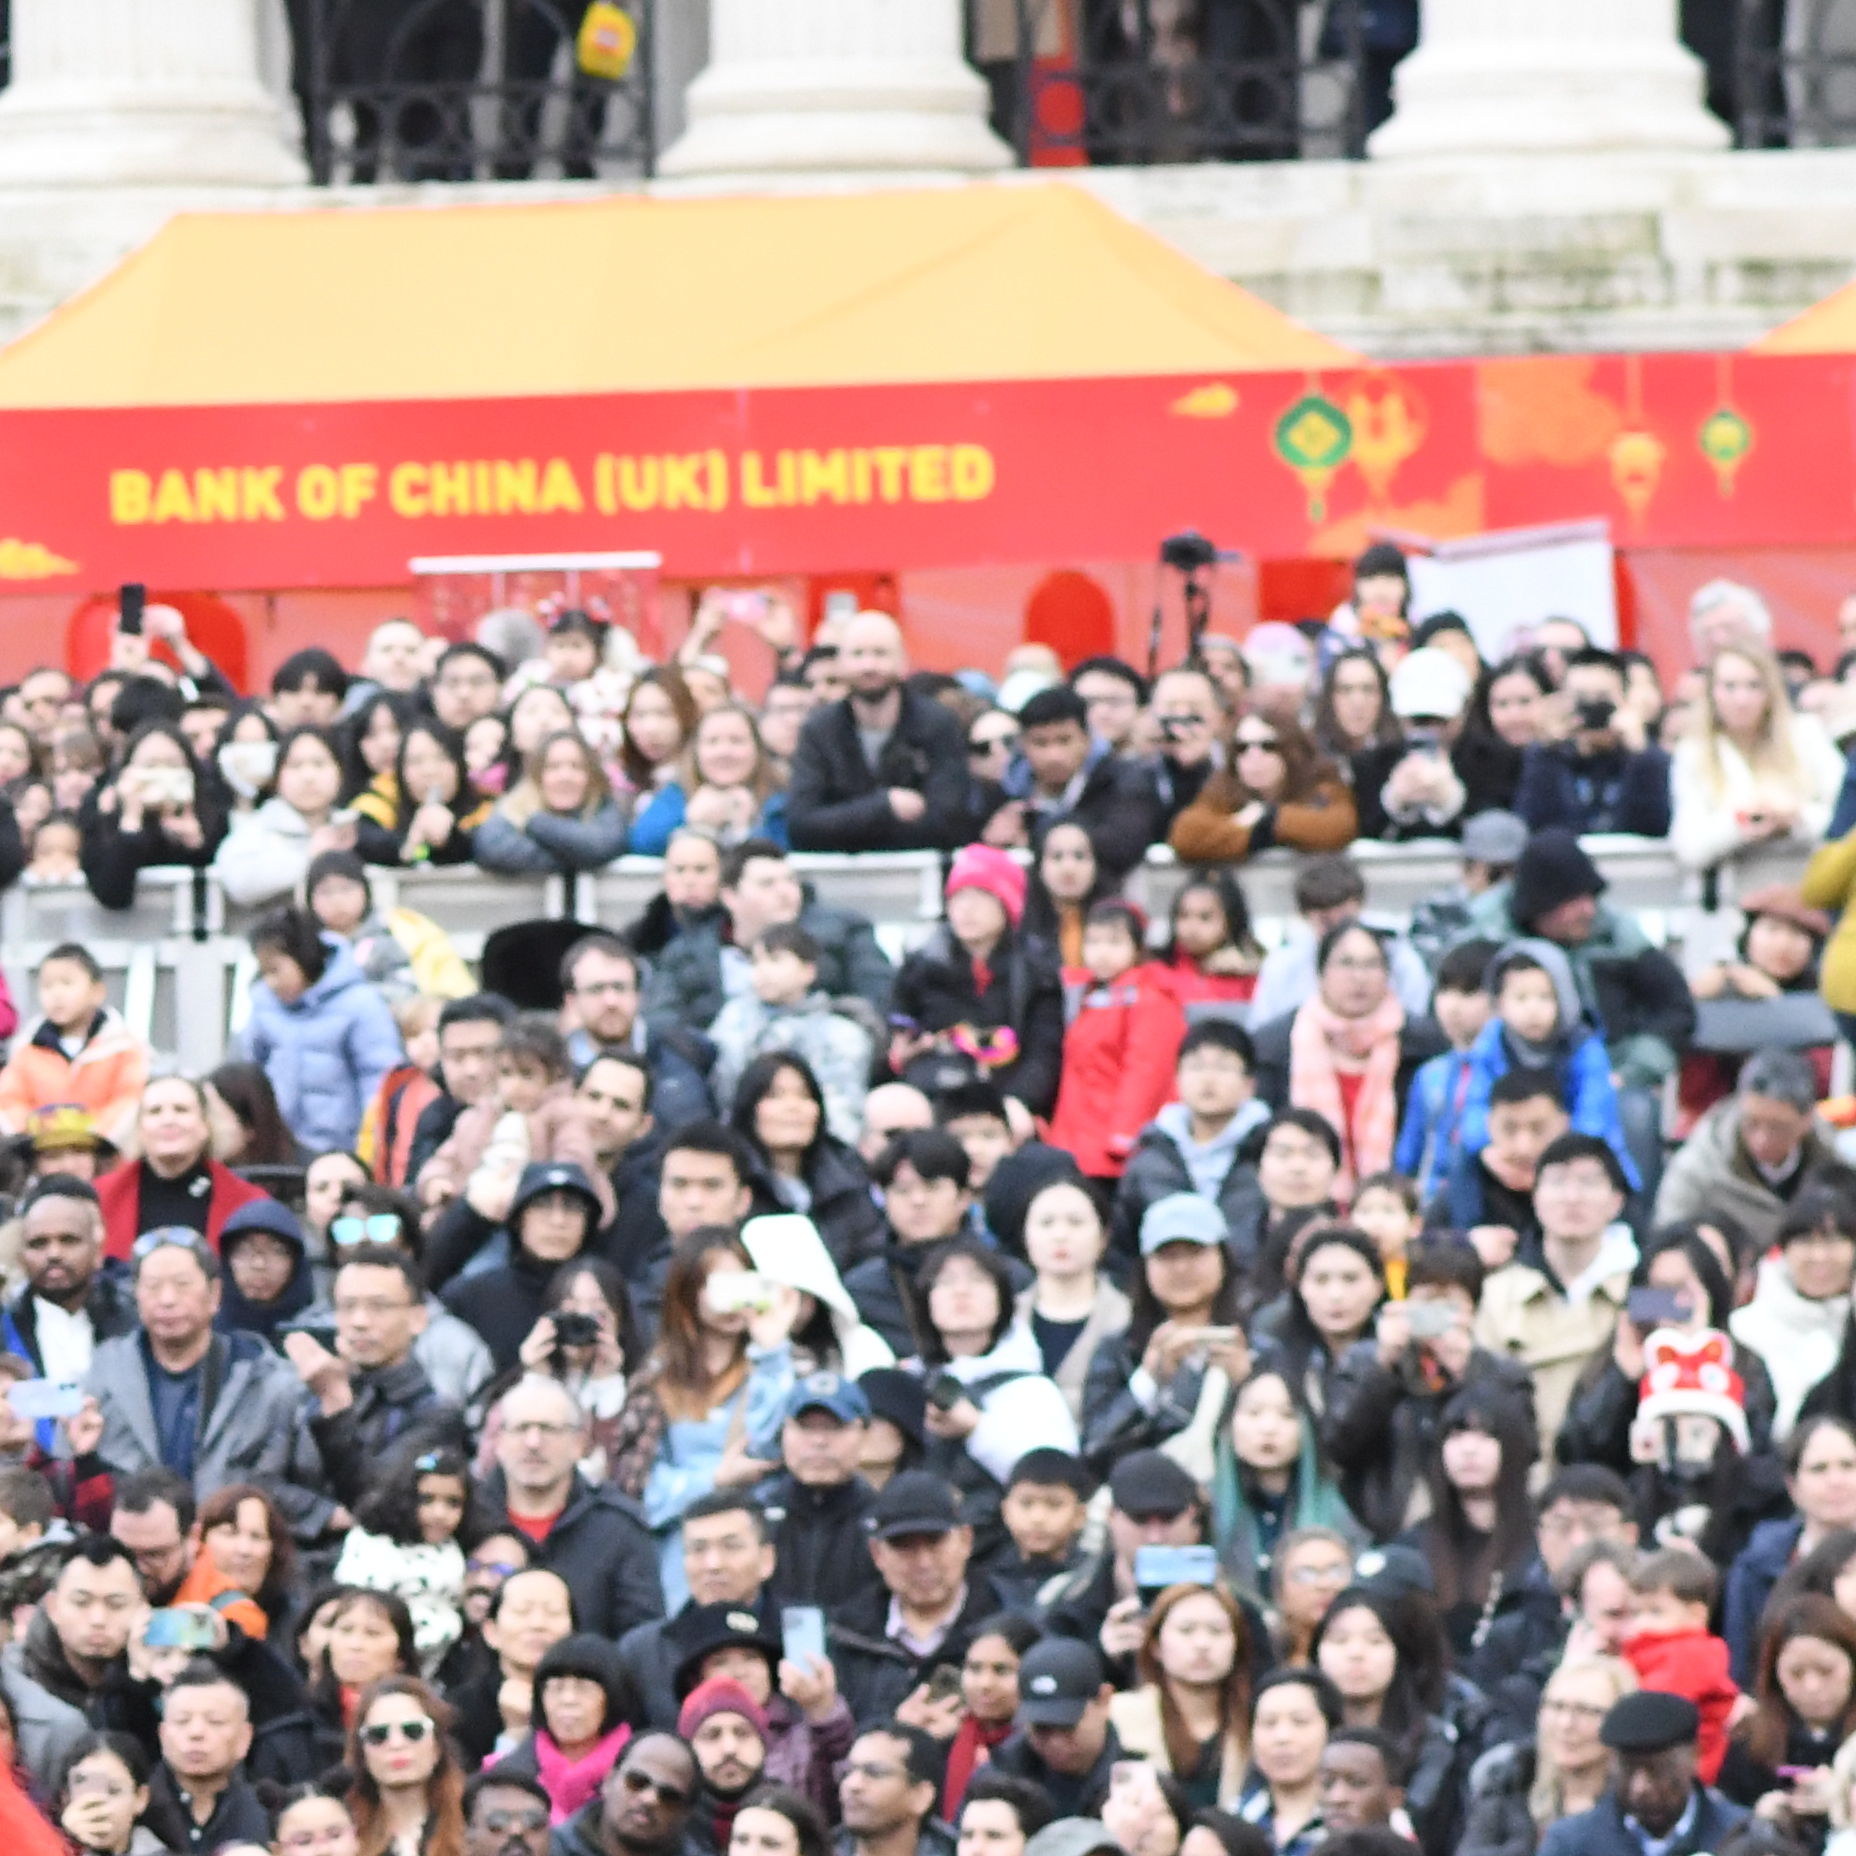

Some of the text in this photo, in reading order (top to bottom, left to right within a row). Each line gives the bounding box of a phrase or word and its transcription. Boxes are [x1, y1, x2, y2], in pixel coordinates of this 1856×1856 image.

[109, 444, 994, 524] BANK OF CHINA (UK) LIMITED
